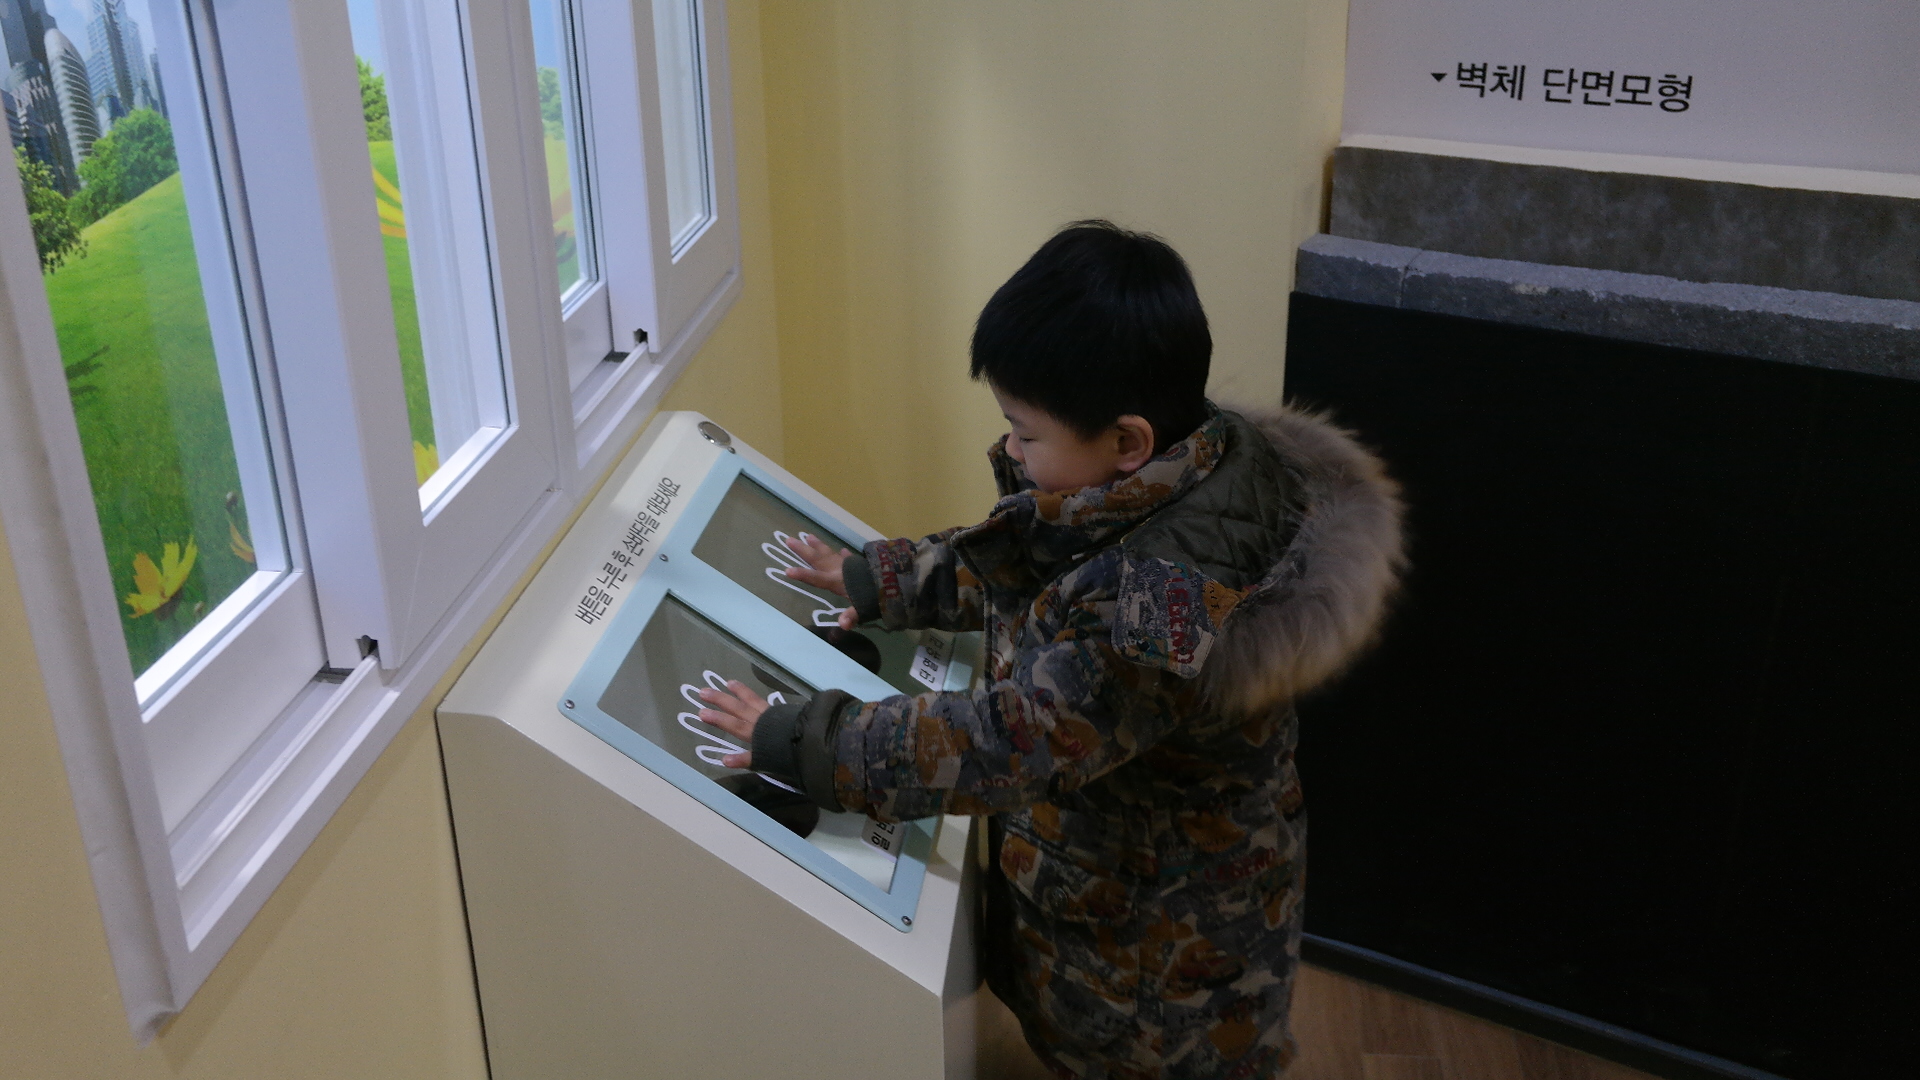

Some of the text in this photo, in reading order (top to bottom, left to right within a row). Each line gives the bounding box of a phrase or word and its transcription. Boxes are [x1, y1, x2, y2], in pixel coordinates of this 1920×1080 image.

[1456, 62, 1693, 113] 벽체 단면모형
[575, 477, 681, 624] 버튼을 누른 후 손바닥을 대보세요
[1164, 577, 1195, 664] LEGEND
